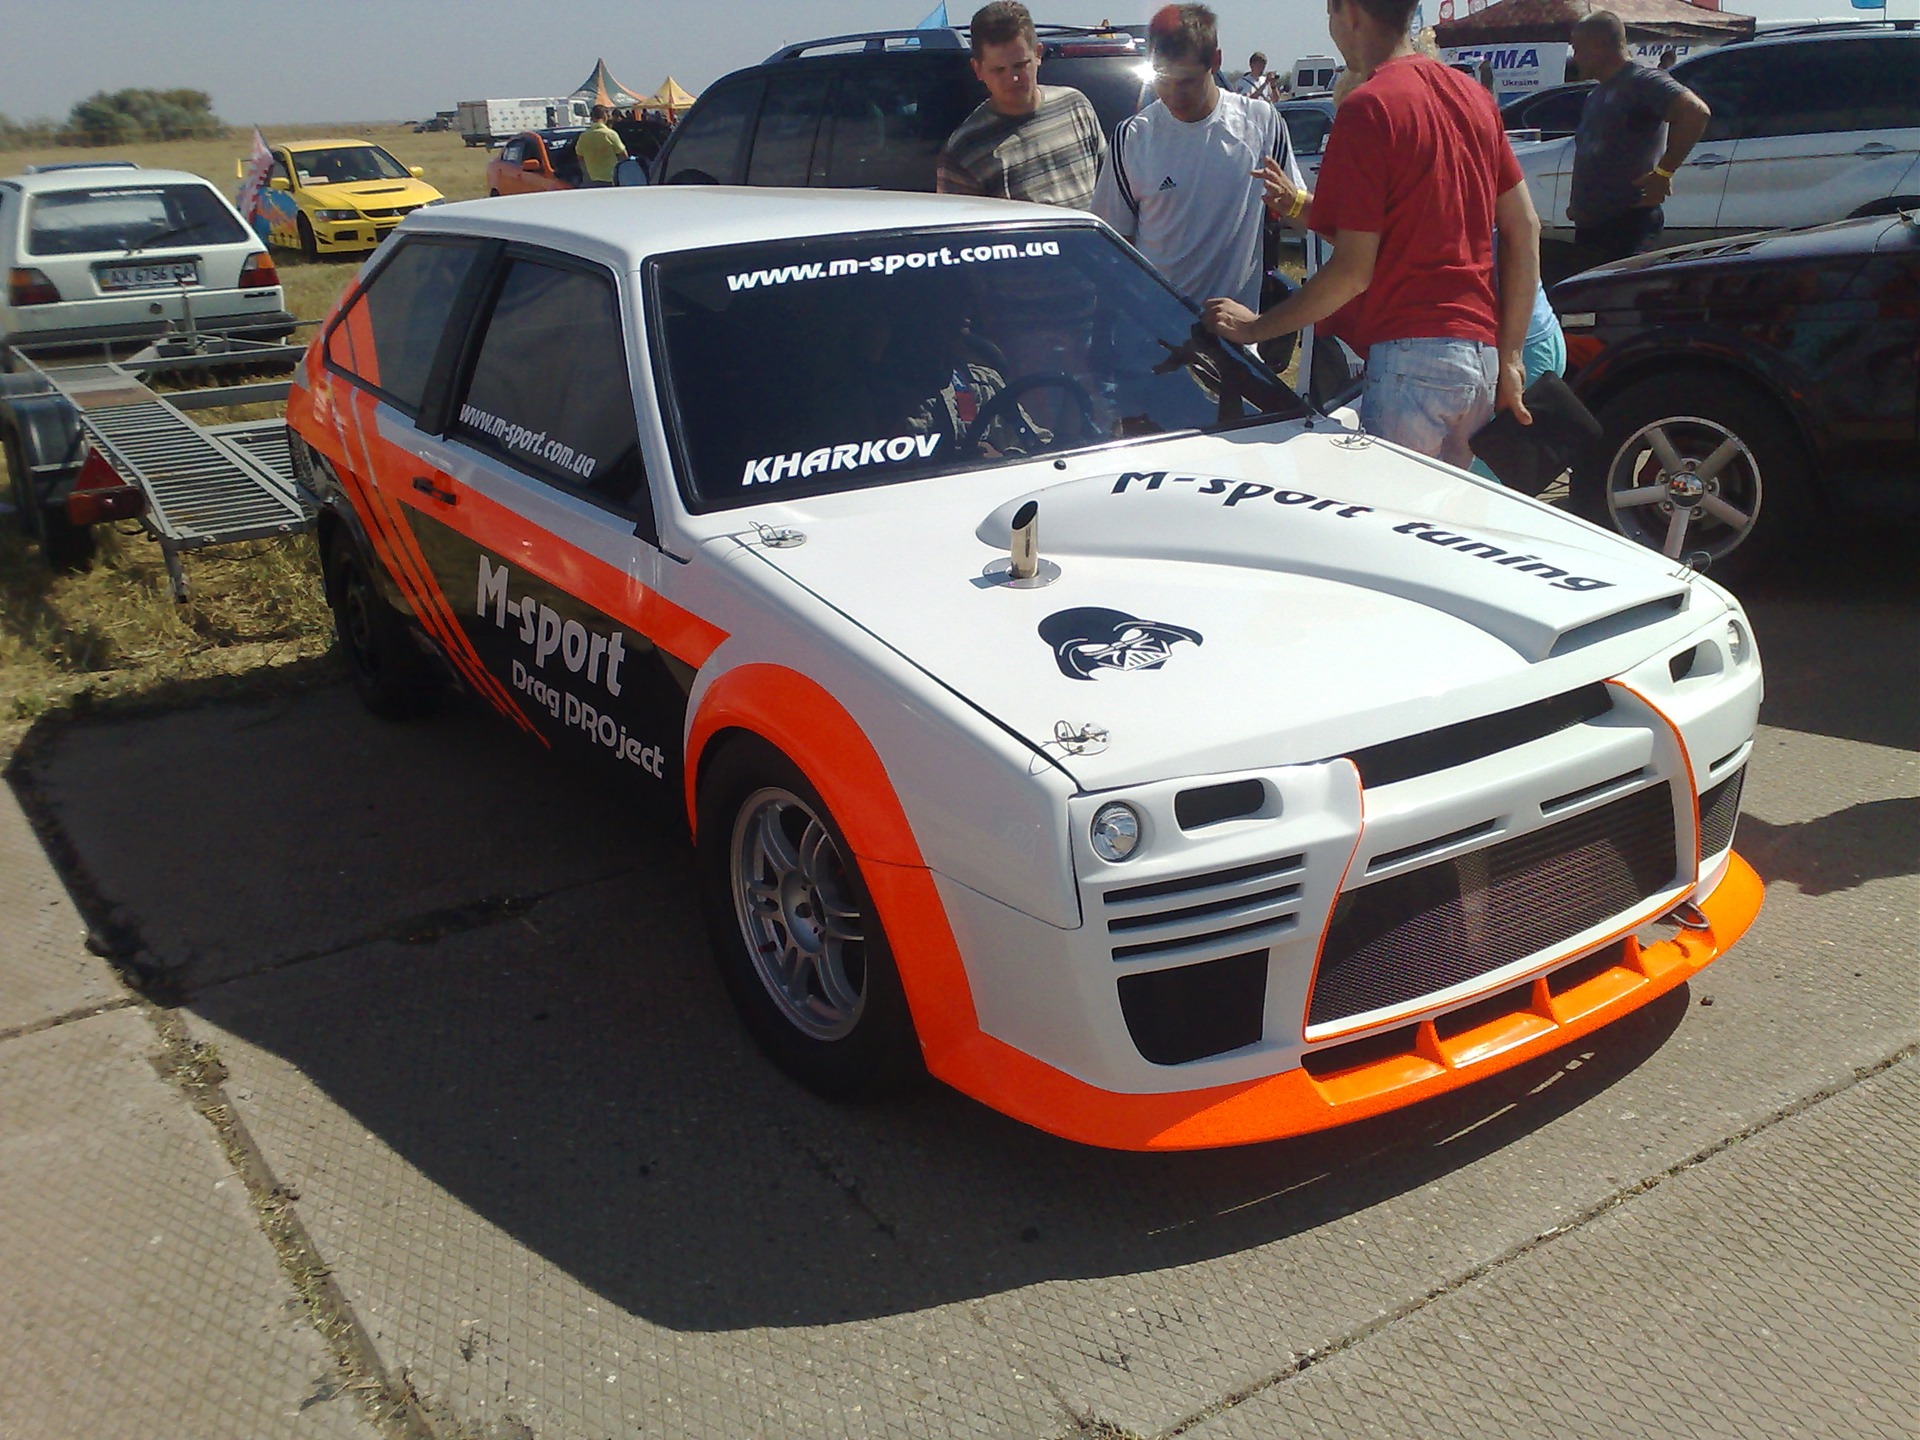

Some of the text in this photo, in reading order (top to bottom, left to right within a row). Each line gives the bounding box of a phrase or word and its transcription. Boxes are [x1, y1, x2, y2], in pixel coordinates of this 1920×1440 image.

[727, 241, 1060, 292] www.m-sport.com.ua
[459, 404, 596, 478] www.m-sport.com.ua
[742, 433, 941, 486] KHARKOV
[1111, 471, 1616, 592] M-sport tuning
[477, 554, 625, 697] M-sport
[512, 659, 560, 718] Drag
